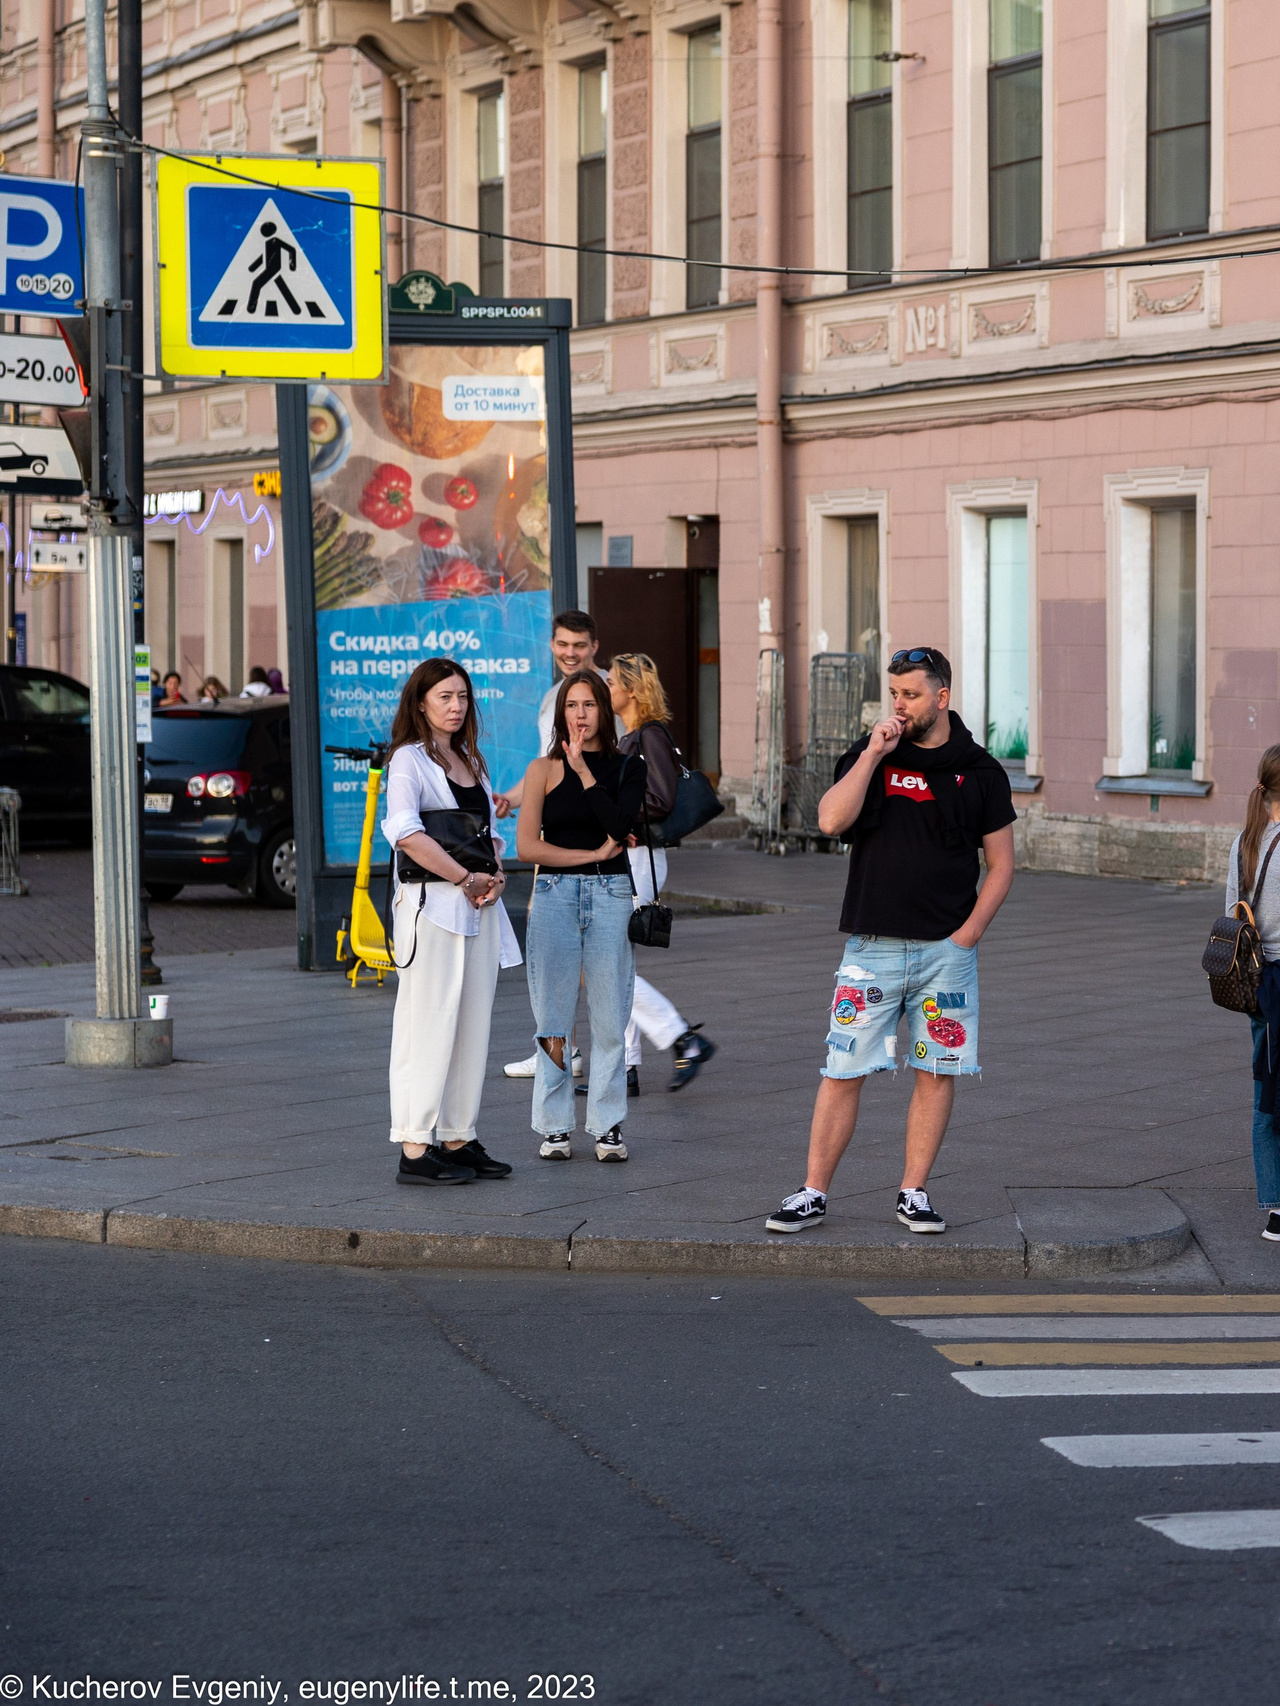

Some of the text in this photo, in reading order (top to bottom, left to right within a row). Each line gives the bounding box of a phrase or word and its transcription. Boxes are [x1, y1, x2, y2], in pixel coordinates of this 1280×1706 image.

[0, 192, 63, 296] P
[20, 278, 72, 294] 10 15 20
[461, 306, 542, 319] SPPSPL0041
[454, 384, 521, 398] Доставка
[454, 400, 536, 414] от 10 минут
[329, 630, 481, 655] Скидка 40%
[330, 658, 531, 679] на перв заказ
[330, 687, 505, 701] Чтобы мож зять
[330, 706, 367, 718] всего
[333, 753, 370, 774] Янд
[333, 781, 359, 793] вот
[890, 773, 928, 791] Lev
